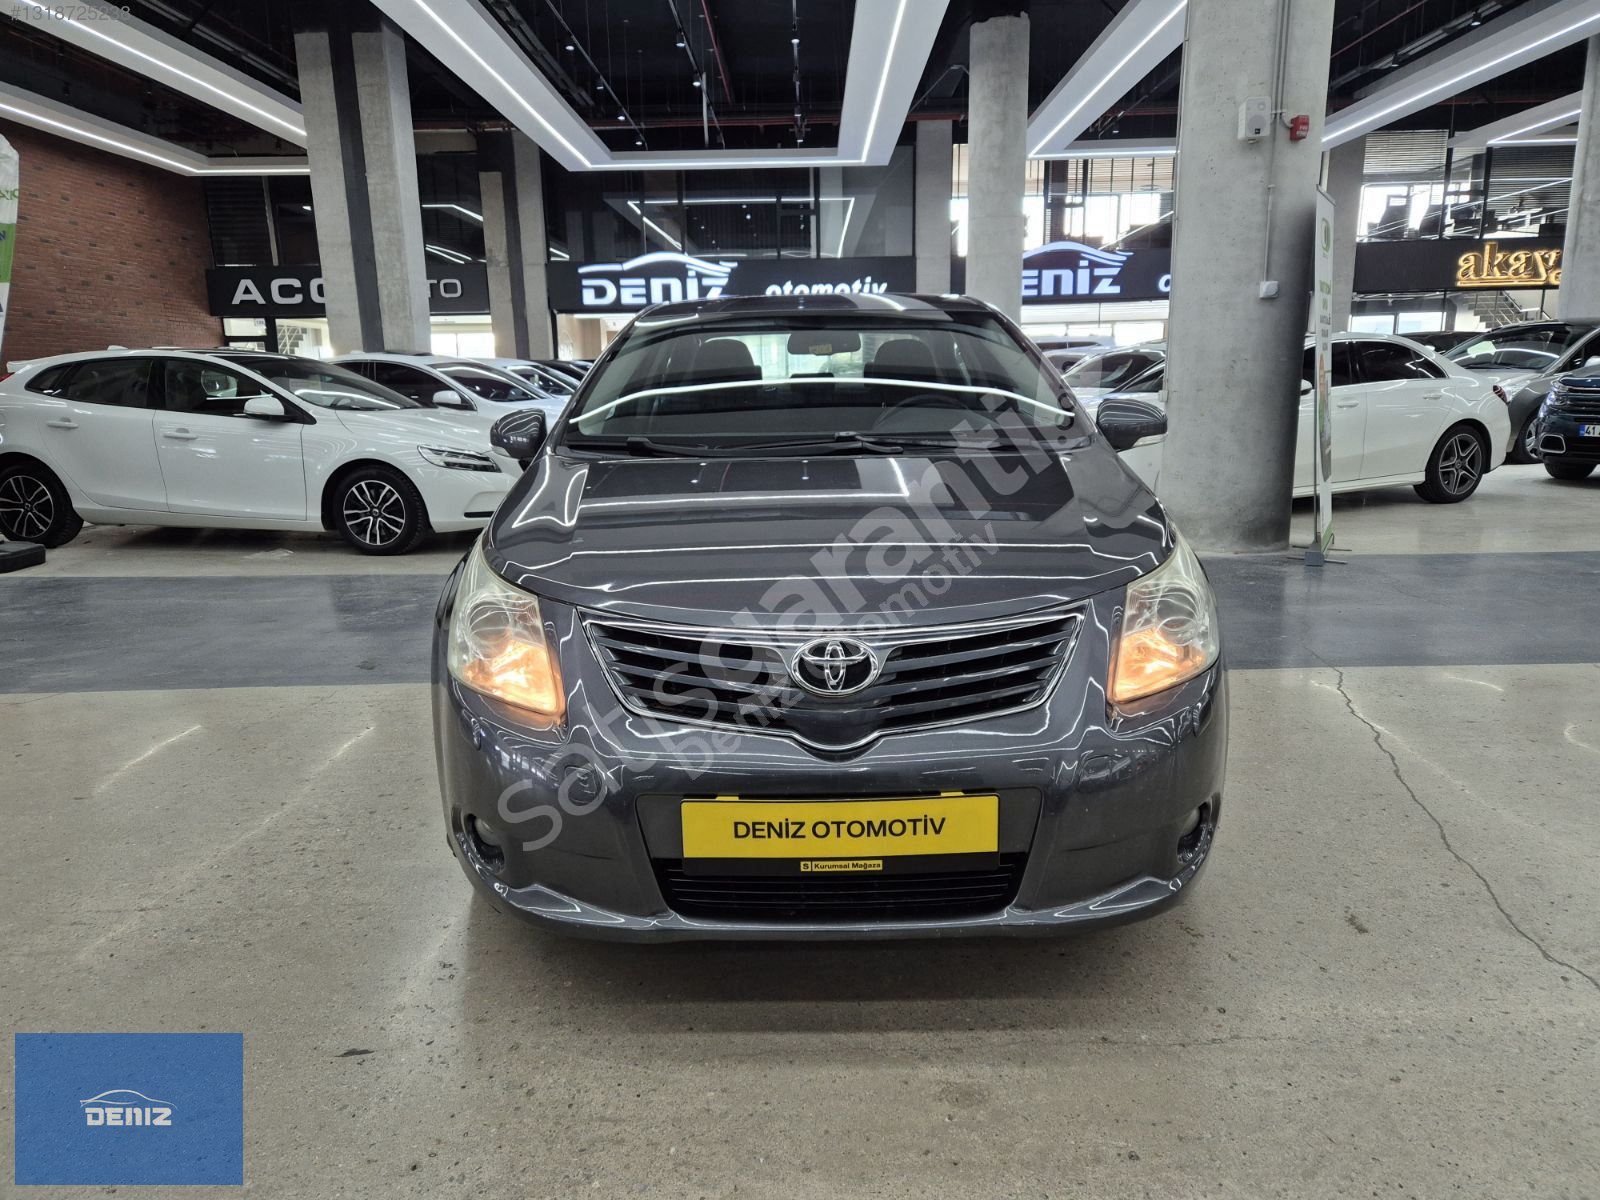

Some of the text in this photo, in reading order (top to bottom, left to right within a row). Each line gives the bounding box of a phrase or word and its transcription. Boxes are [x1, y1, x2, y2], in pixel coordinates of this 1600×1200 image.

[765, 275, 888, 295] otomotiv
[733, 814, 946, 839] DENİZ OTOMOTİV
[813, 862, 850, 870] Kurumsal
[851, 861, 881, 870] Mağaza
